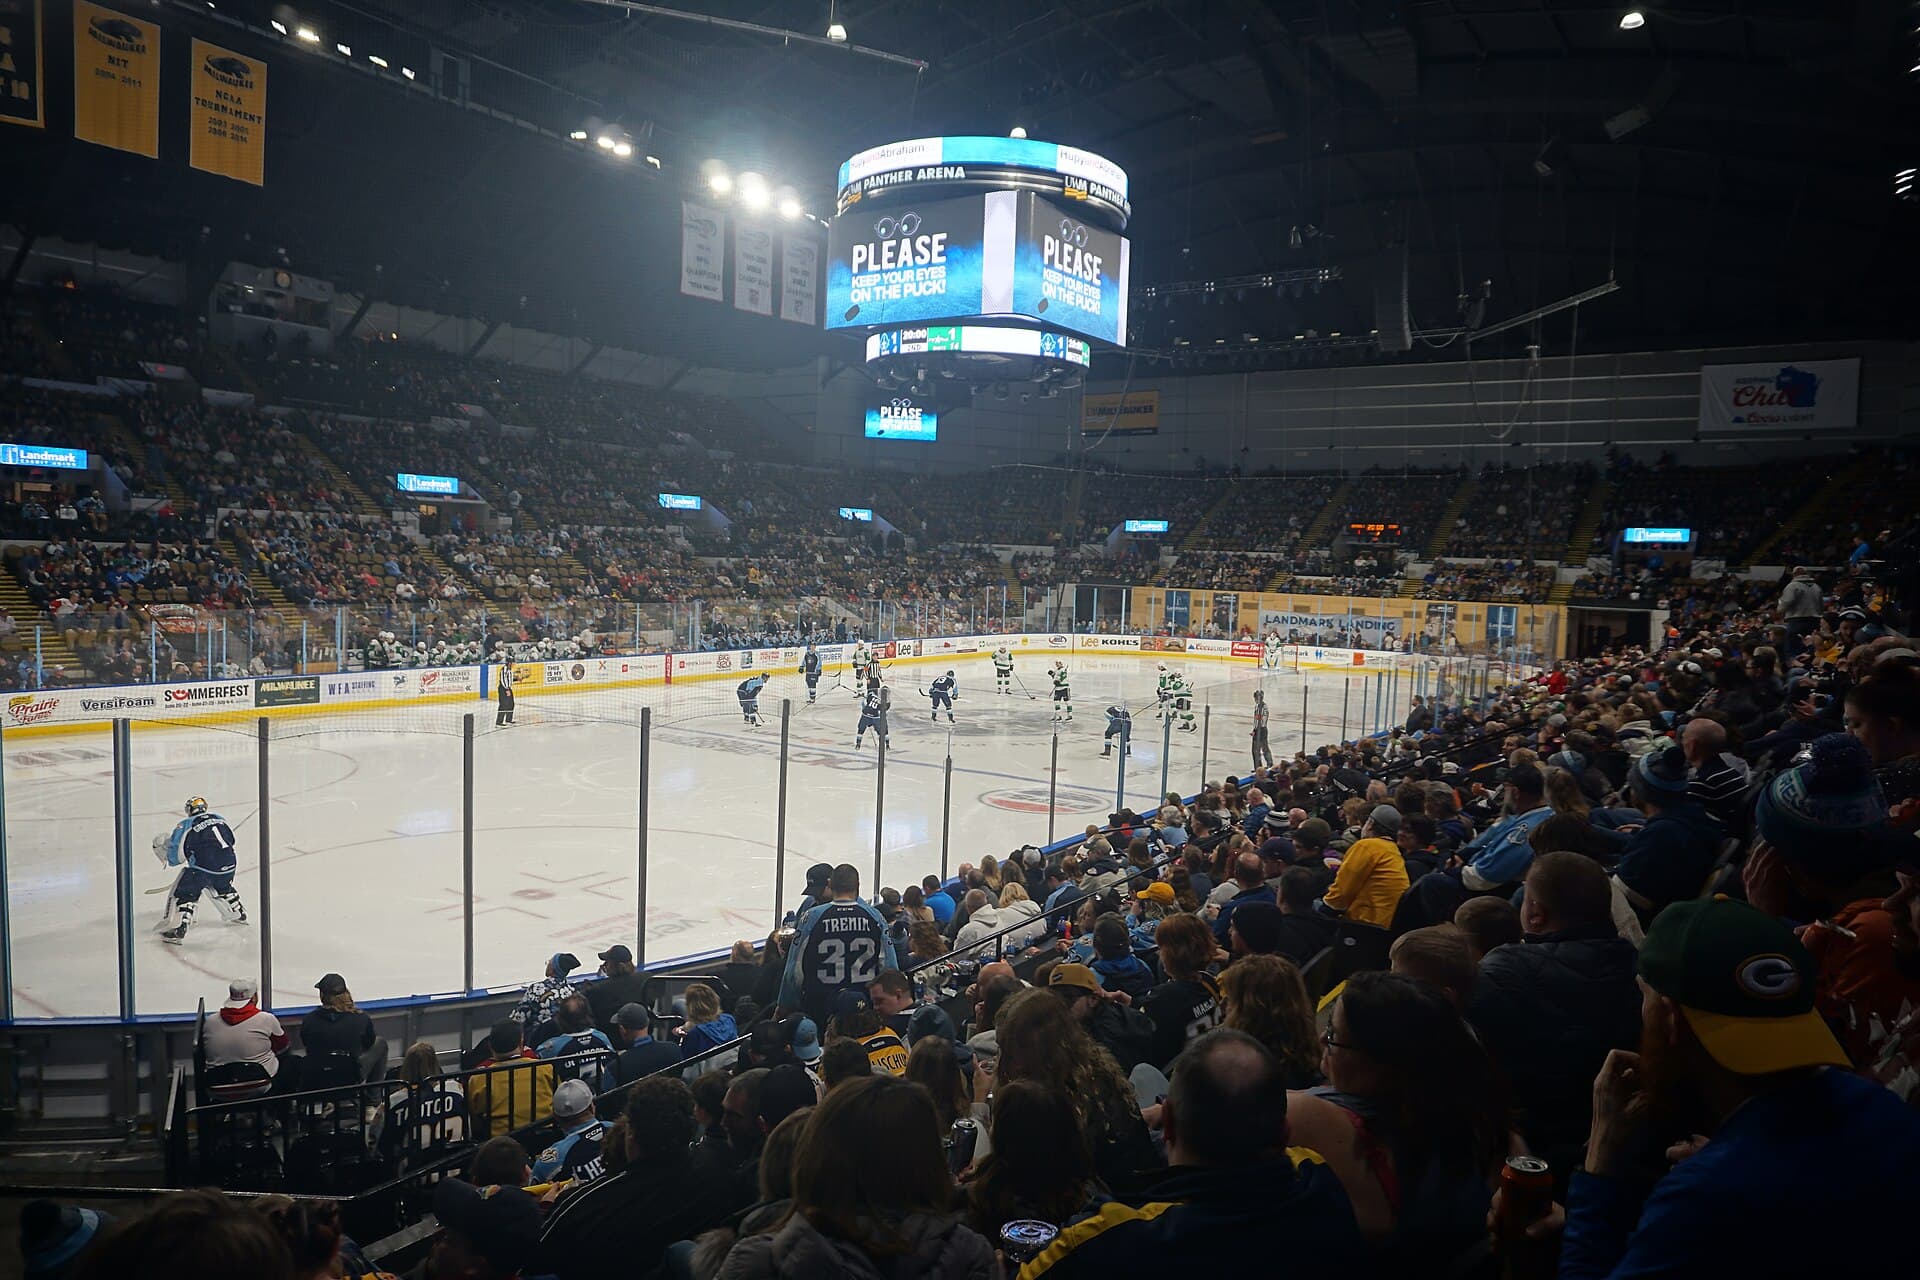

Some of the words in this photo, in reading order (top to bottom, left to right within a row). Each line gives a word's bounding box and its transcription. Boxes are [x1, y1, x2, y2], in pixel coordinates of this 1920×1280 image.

[215, 89, 242, 105] NCAA
[194, 96, 263, 125] TOURNAMENT
[863, 169, 913, 190] PANTHER
[916, 166, 966, 180] ARENA
[851, 232, 948, 274] PLEASE
[1043, 234, 1102, 286] PLEASE
[851, 275, 881, 289] KEEP
[881, 269, 916, 285] YOUR
[916, 265, 946, 281] EYES
[1043, 267, 1063, 284] KEEP
[1063, 274, 1085, 293] YOUR
[1084, 282, 1101, 300] EYES
[850, 287, 871, 303] ON
[873, 284, 902, 300] THE
[903, 279, 946, 298] PUCK!
[1042, 280, 1057, 299] ON
[1057, 286, 1076, 305] THE
[1075, 293, 1101, 315] PUCK!
[891, 331, 897, 345] 1
[948, 327, 956, 340] 1
[1057, 336, 1064, 349] 1
[880, 406, 922, 420] PLEASE
[19, 449, 76, 463] Landmark
[1265, 615, 1334, 627] LANDMARK
[1338, 619, 1396, 631] LANDING
[898, 642, 911, 656] Lee
[1081, 635, 1099, 647] Lee
[1101, 638, 1139, 646] KOHL'S
[13, 698, 60, 715] Prairie
[81, 696, 155, 713] VersiFoam
[211, 825, 230, 849] 1
[817, 937, 876, 985] 32
